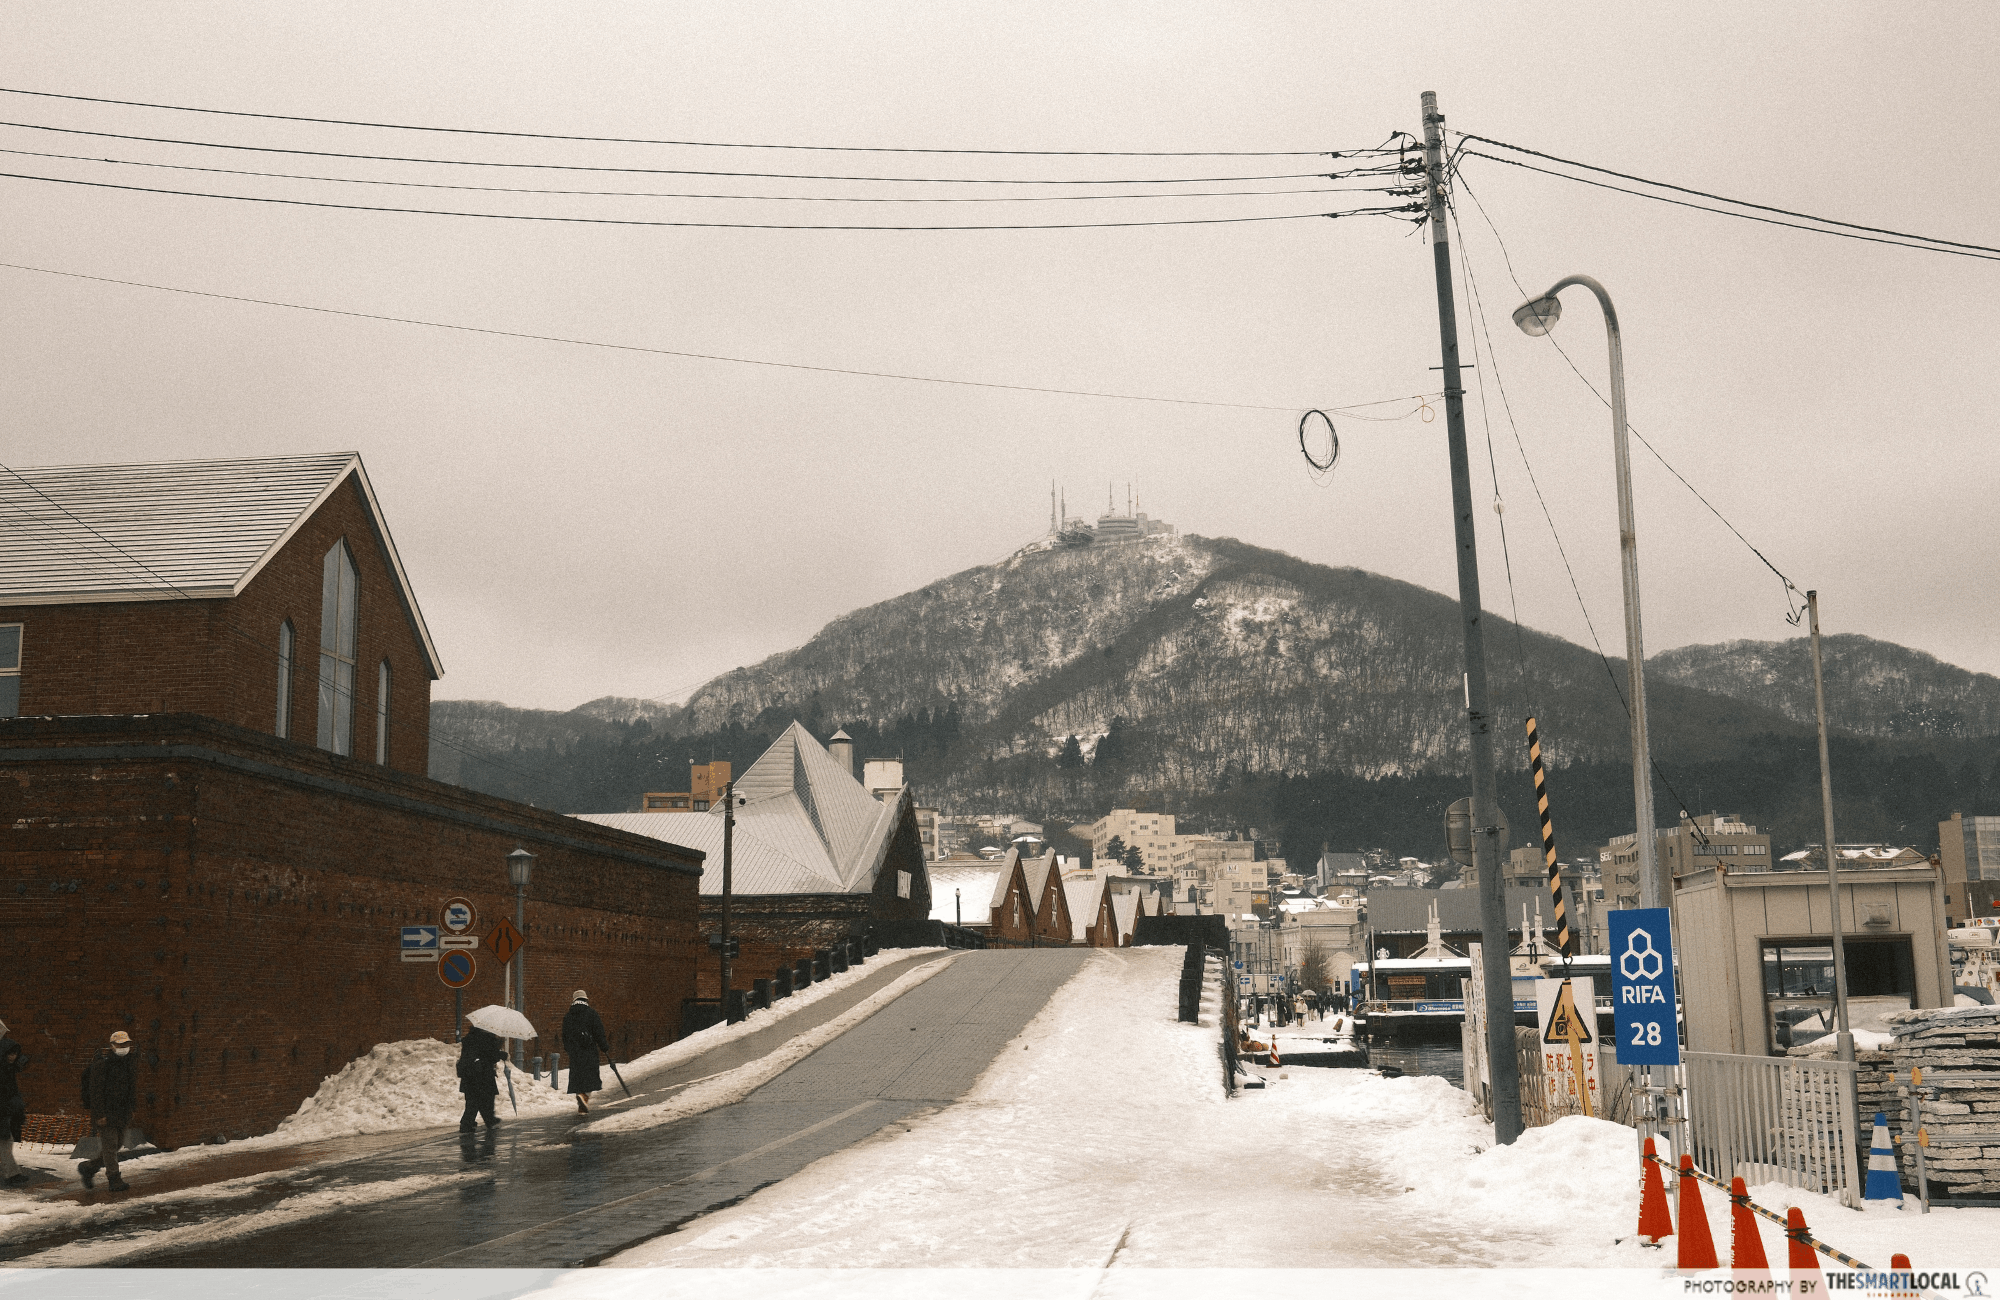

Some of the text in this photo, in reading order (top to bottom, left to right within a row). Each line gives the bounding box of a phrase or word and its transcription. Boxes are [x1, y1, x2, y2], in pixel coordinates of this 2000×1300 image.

[1621, 985, 1666, 1004] RIFA
[1630, 1021, 1662, 1046] 28
[1546, 1053, 1594, 1072] 防犯カラ
